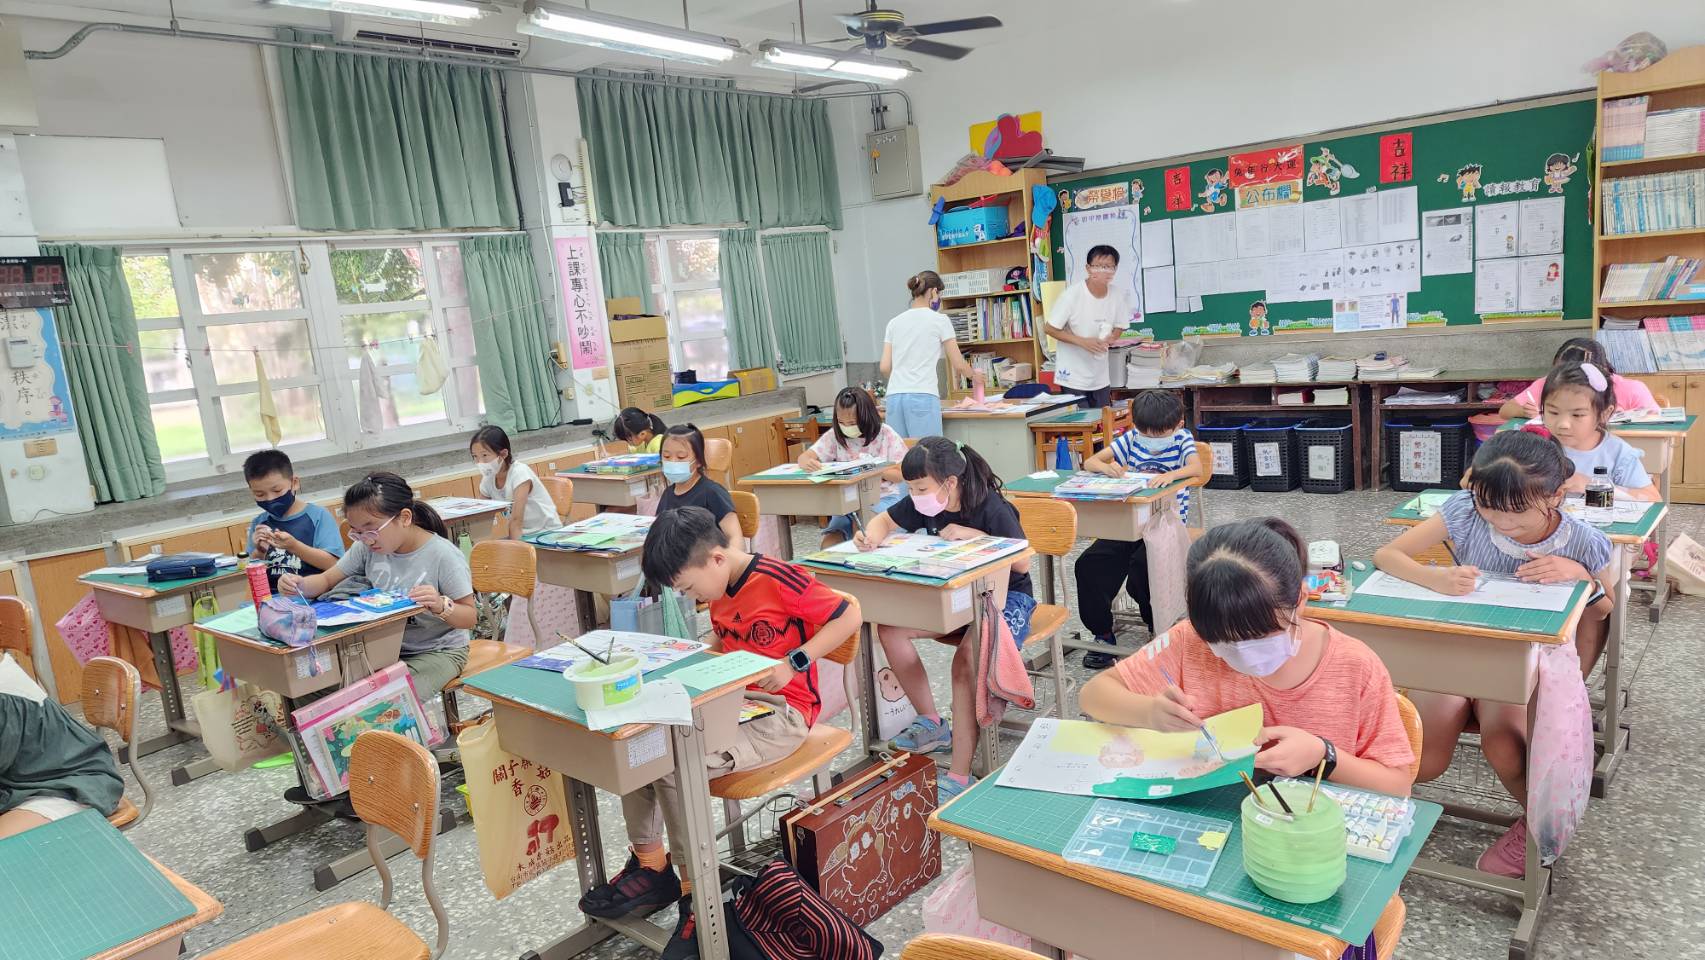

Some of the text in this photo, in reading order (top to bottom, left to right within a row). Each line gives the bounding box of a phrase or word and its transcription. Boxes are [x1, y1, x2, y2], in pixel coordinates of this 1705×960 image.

[1234, 159, 1297, 177] 兔年行大運
[1391, 138, 1411, 181] 吉祥
[1246, 184, 1292, 204] 公布欄
[1485, 180, 1540, 197] 讀報教育
[567, 243, 593, 357] 上課專心不吵鬧
